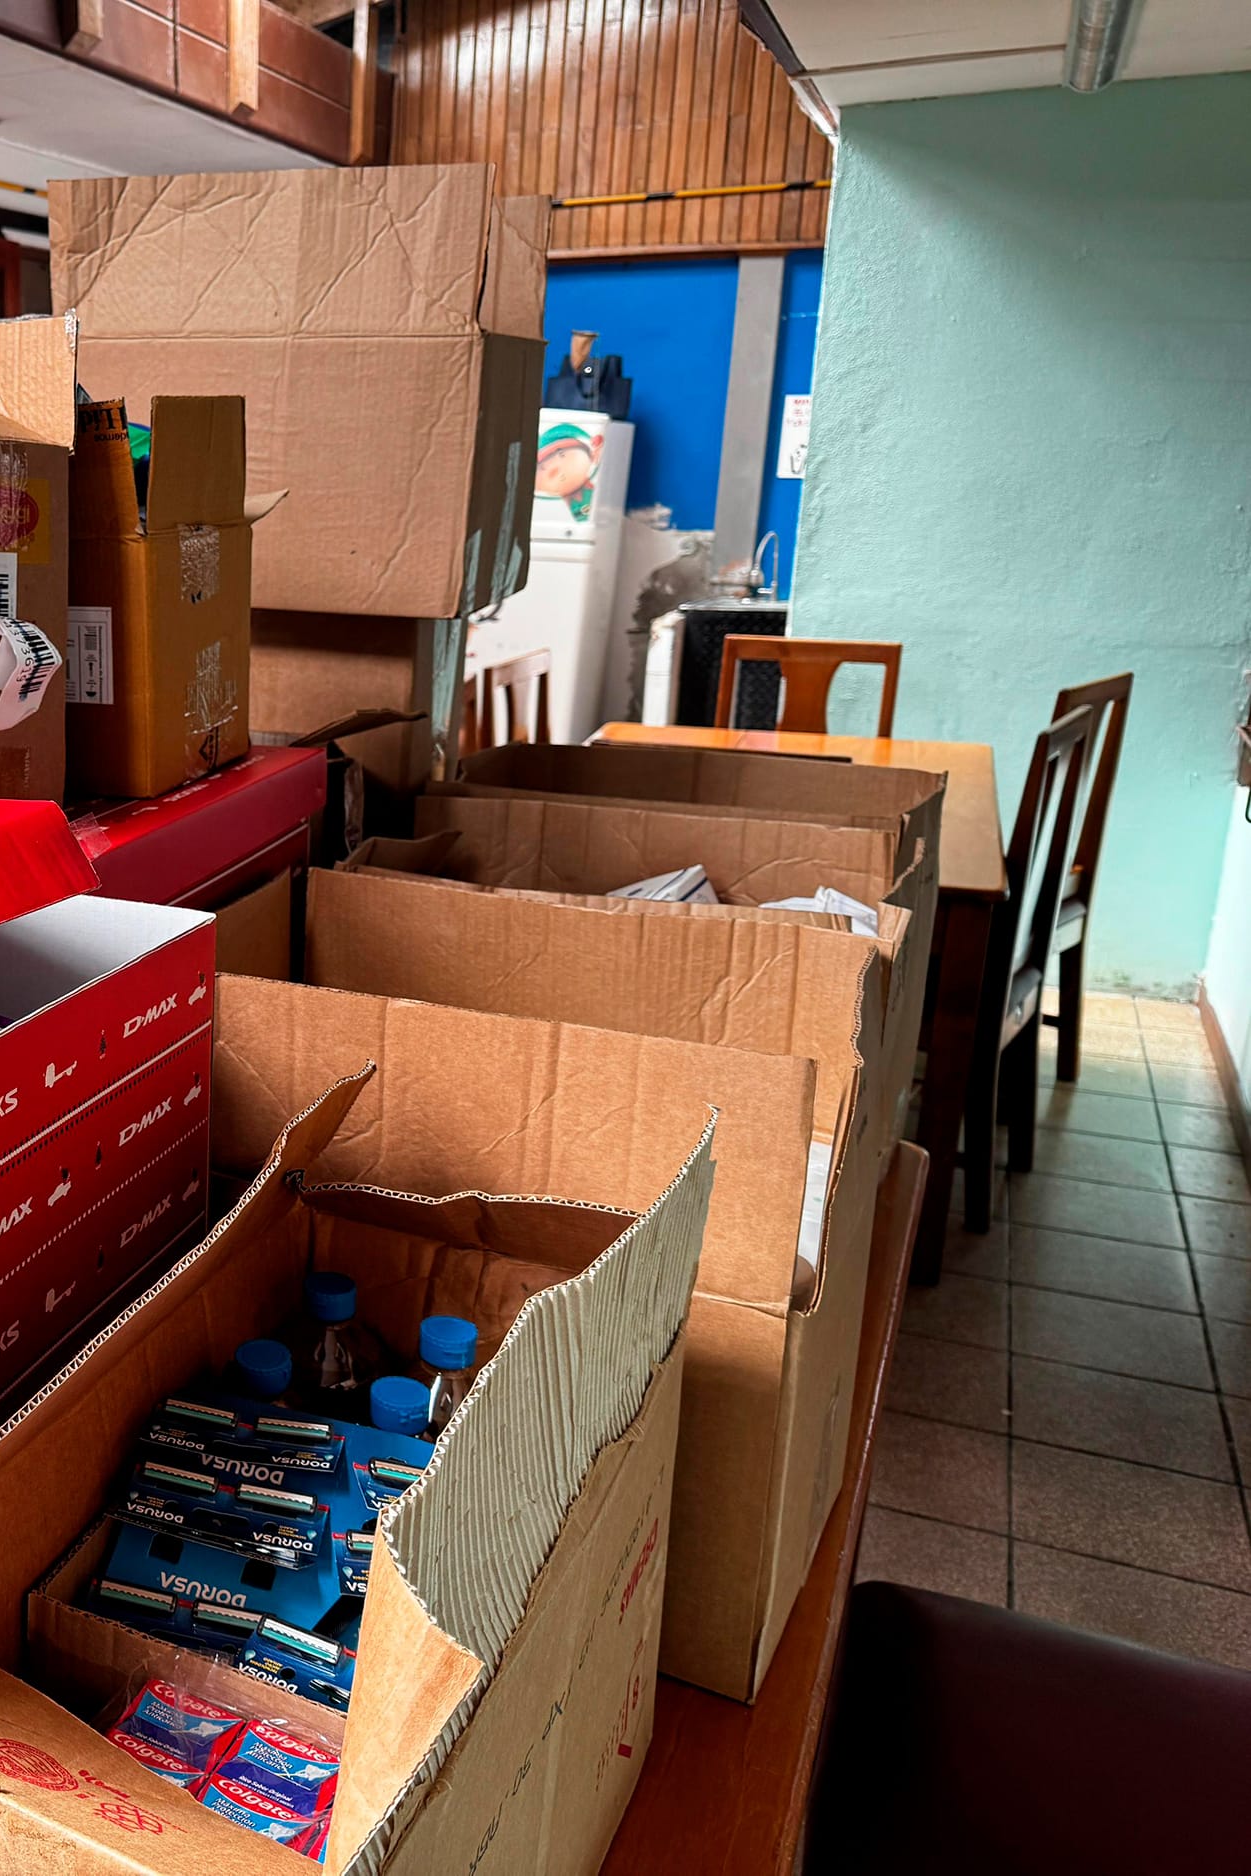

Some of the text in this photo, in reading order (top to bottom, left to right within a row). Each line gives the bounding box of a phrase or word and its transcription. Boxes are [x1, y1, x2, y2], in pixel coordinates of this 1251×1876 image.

[119, 1096, 172, 1146] D-MAX
[150, 1432, 205, 1450] DORUSA
[201, 1453, 284, 1485] DORUSA
[272, 1456, 330, 1469] DORUSA
[127, 1502, 184, 1524] DORUSA
[253, 1532, 313, 1551] DORUSA
[160, 1571, 247, 1609] DORUSA
[239, 1662, 298, 1694] DORUSA
[114, 1734, 183, 1771] Colgate
[218, 1779, 290, 1820] Colgate
